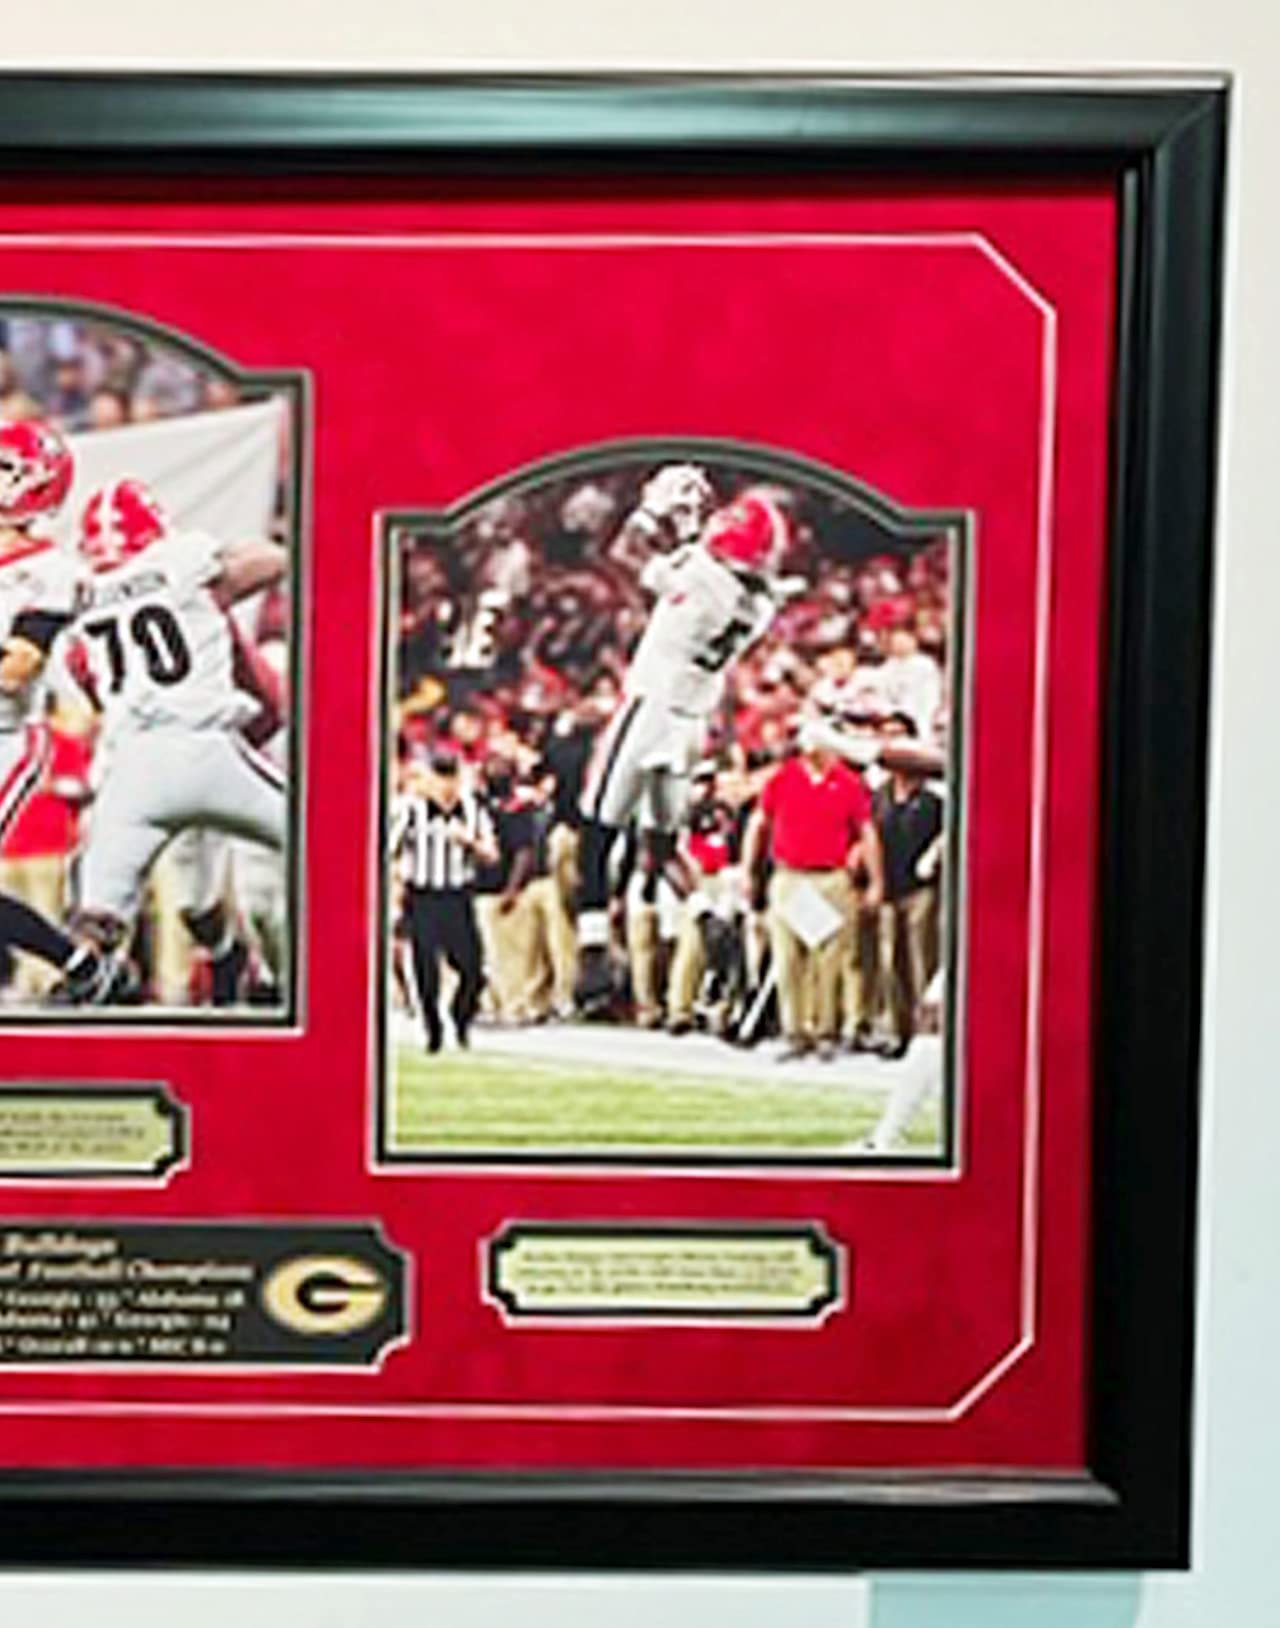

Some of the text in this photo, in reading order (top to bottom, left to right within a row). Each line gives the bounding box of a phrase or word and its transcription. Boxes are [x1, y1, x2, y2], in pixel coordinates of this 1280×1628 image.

[84, 605, 193, 688] 70
[4, 1233, 117, 1259] Bulldogs
[27, 1260, 121, 1282] Football
[127, 1259, 254, 1285] Champions
[4, 1290, 80, 1311] Georgia
[139, 1291, 219, 1308] Alabama
[263, 1255, 384, 1333] G
[114, 1313, 190, 1332] Georgia
[17, 1337, 88, 1354] Overall
